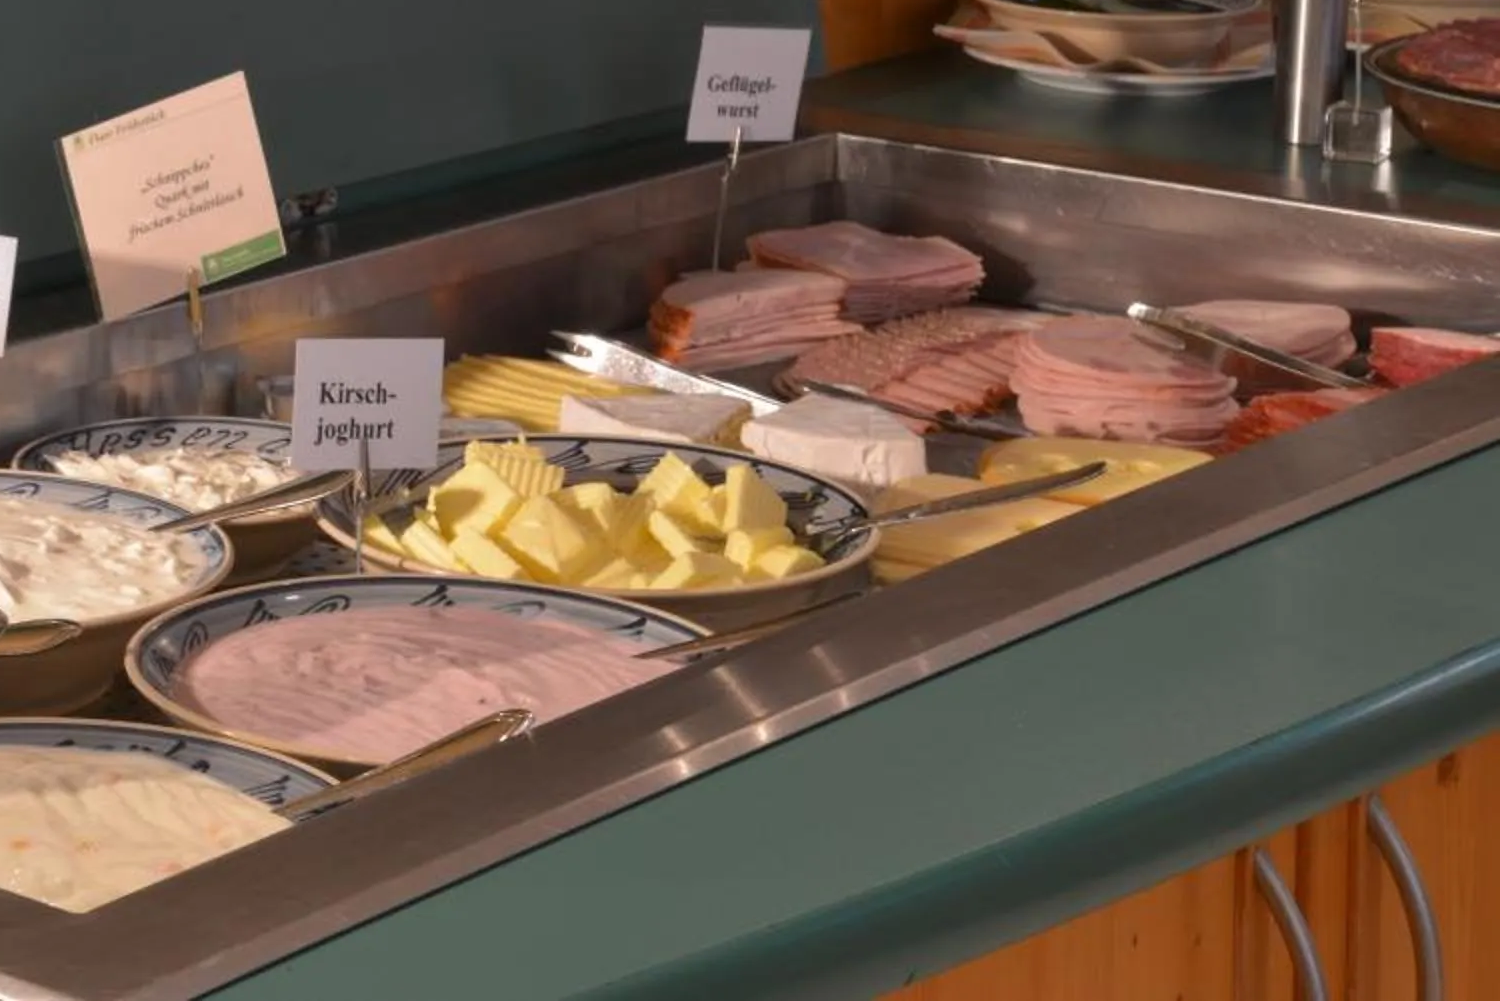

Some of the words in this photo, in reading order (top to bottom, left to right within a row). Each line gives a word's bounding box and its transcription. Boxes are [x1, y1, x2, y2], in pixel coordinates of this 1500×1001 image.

[707, 75, 777, 98] Geflügel-
[717, 103, 760, 119] wurst
[318, 381, 398, 405] Kirsch-
[313, 416, 395, 447] joghurt
